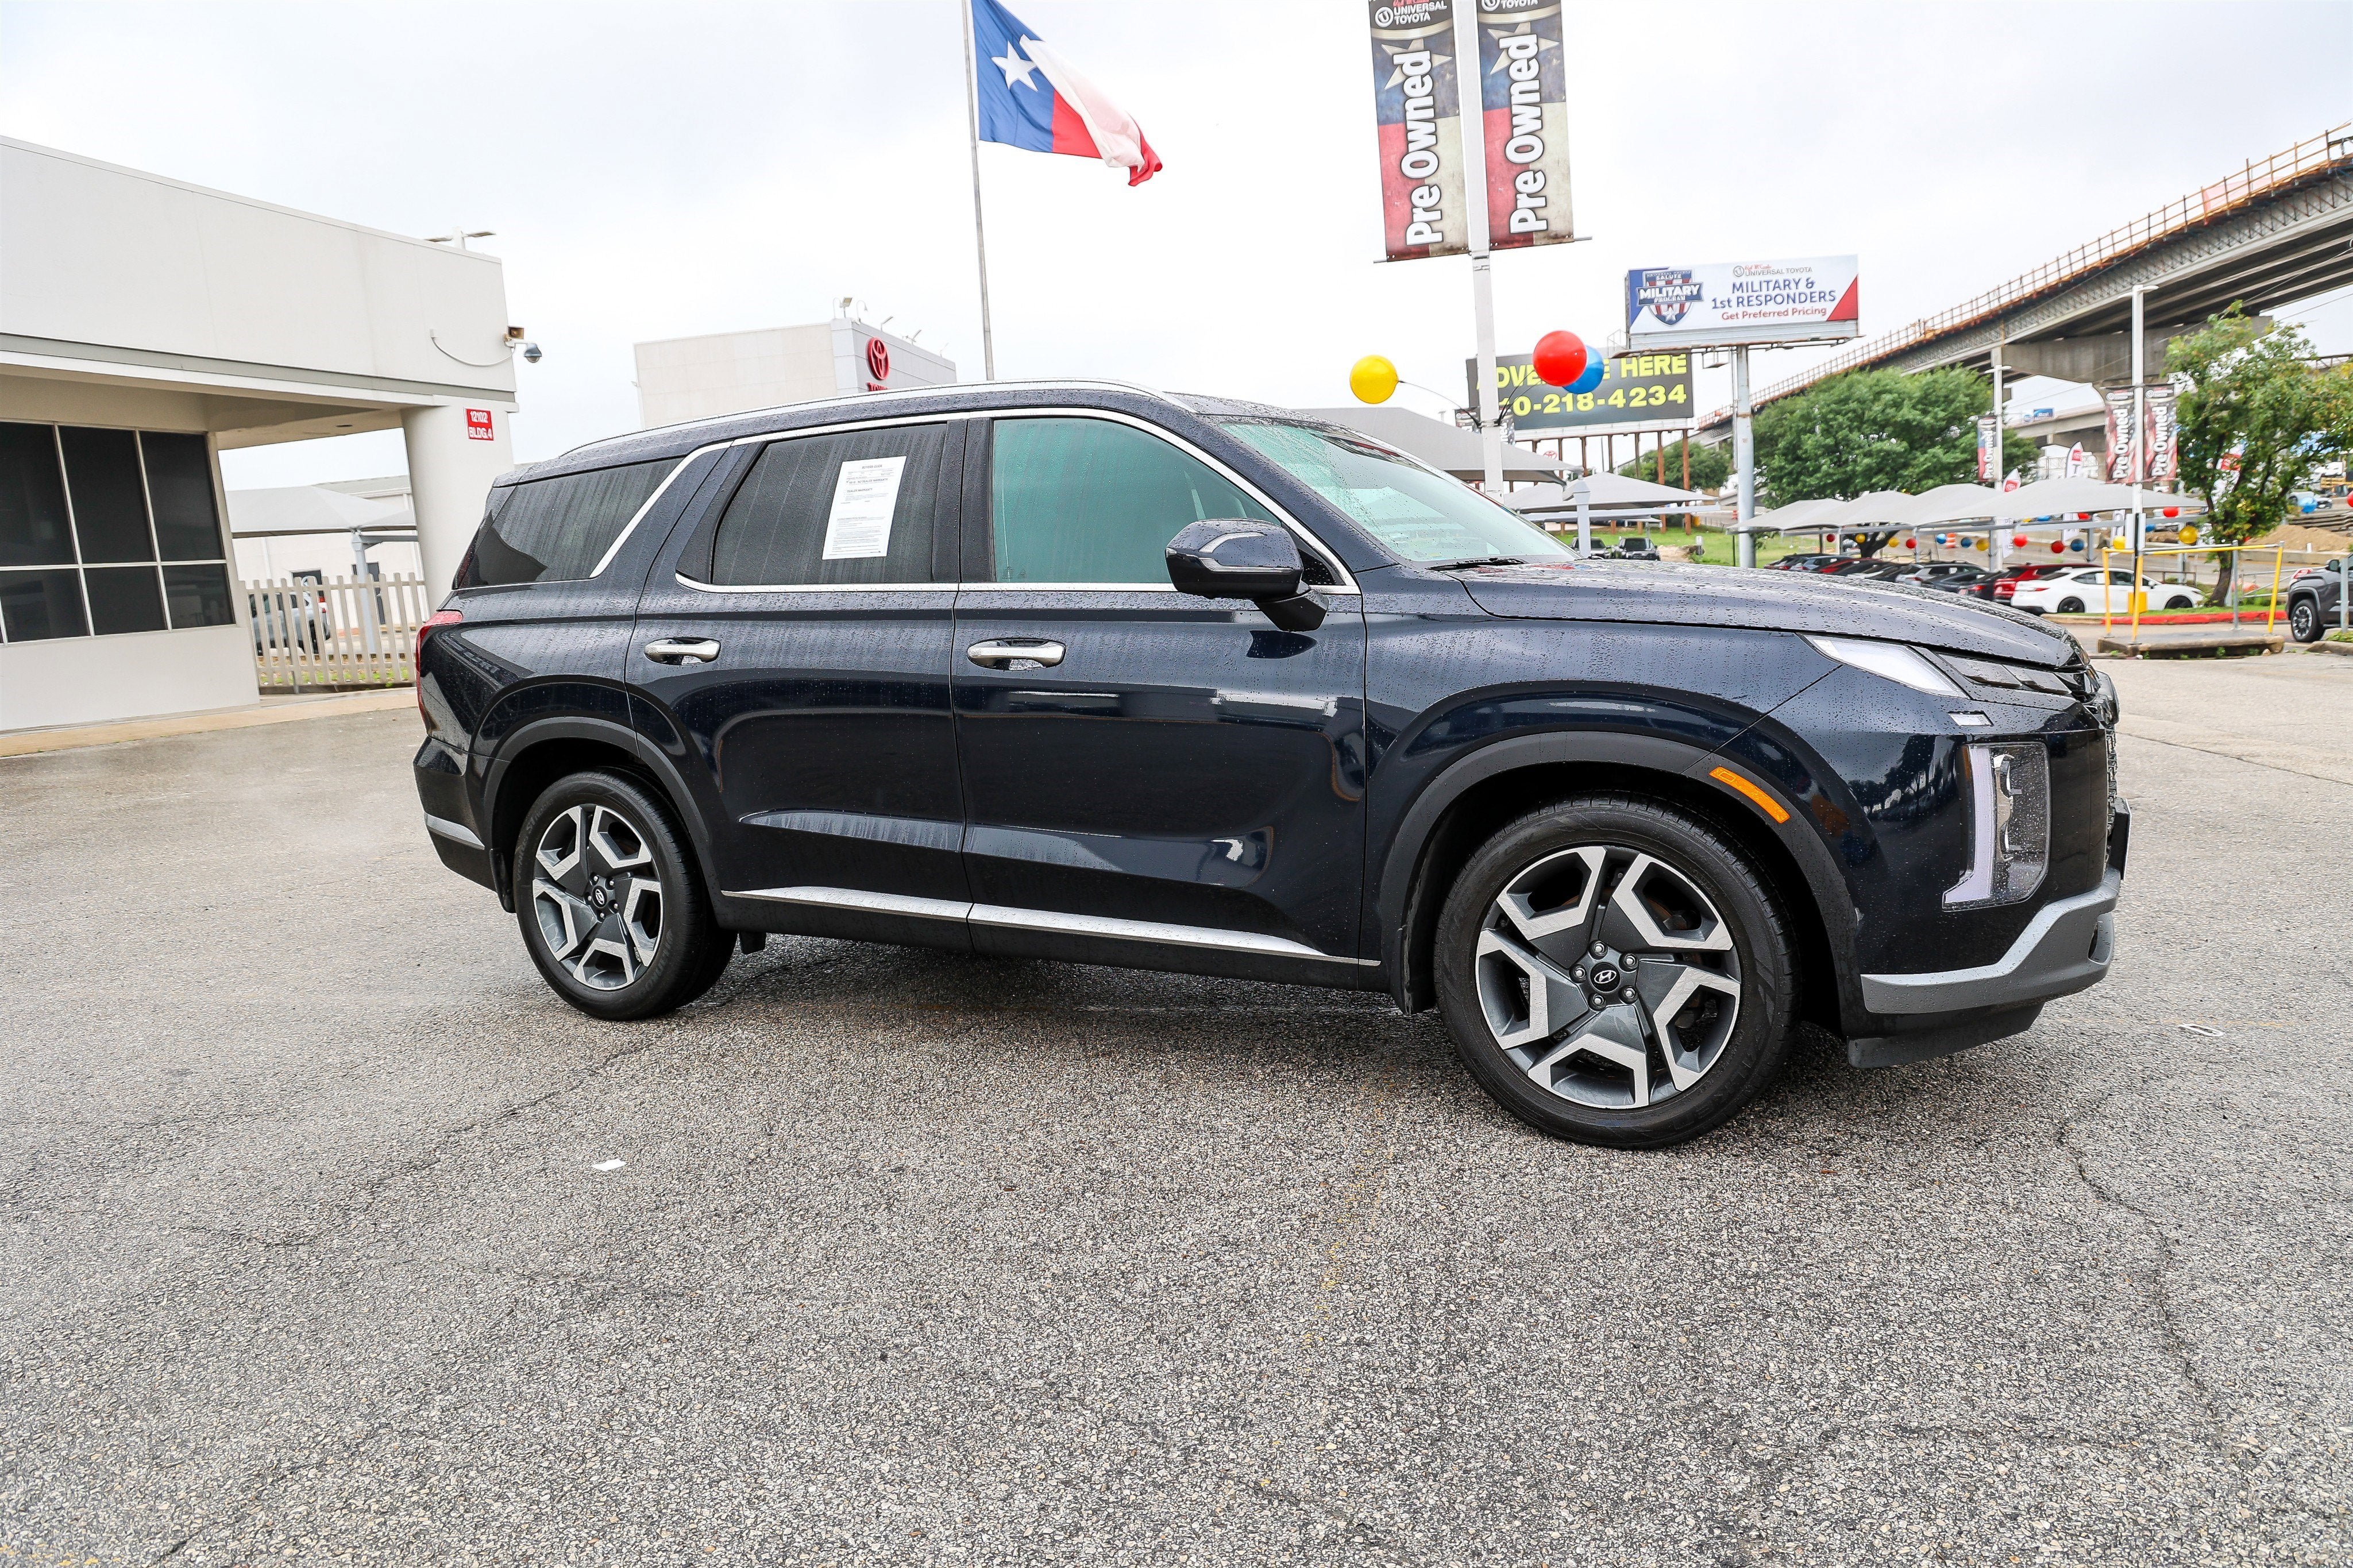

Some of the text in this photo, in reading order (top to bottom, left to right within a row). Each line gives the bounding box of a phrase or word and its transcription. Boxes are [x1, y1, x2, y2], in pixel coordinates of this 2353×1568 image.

[1394, 1, 1447, 16] UNIVERSAL
[1394, 12, 1431, 25] TOYOTA
[1394, 50, 1439, 179] Owned
[1499, 34, 1547, 234] Pre Owned
[1406, 185, 1443, 246] Pre
[1639, 285, 1700, 299] MILITARY
[1732, 277, 1815, 293] MILITARY &
[1712, 289, 1836, 309] 1st RESPONDERS
[1722, 306, 1827, 320] Get Preferred Pricing
[1621, 354, 1687, 379] HERE
[1499, 384, 1687, 418] 0-218-4234
[2112, 408, 2129, 454] Owned
[2151, 406, 2167, 452] Owned
[1982, 430, 1994, 462] Owned
[1983, 463, 1994, 479] Pre
[2112, 455, 2129, 478] Pre
[2151, 453, 2167, 476] Pre
